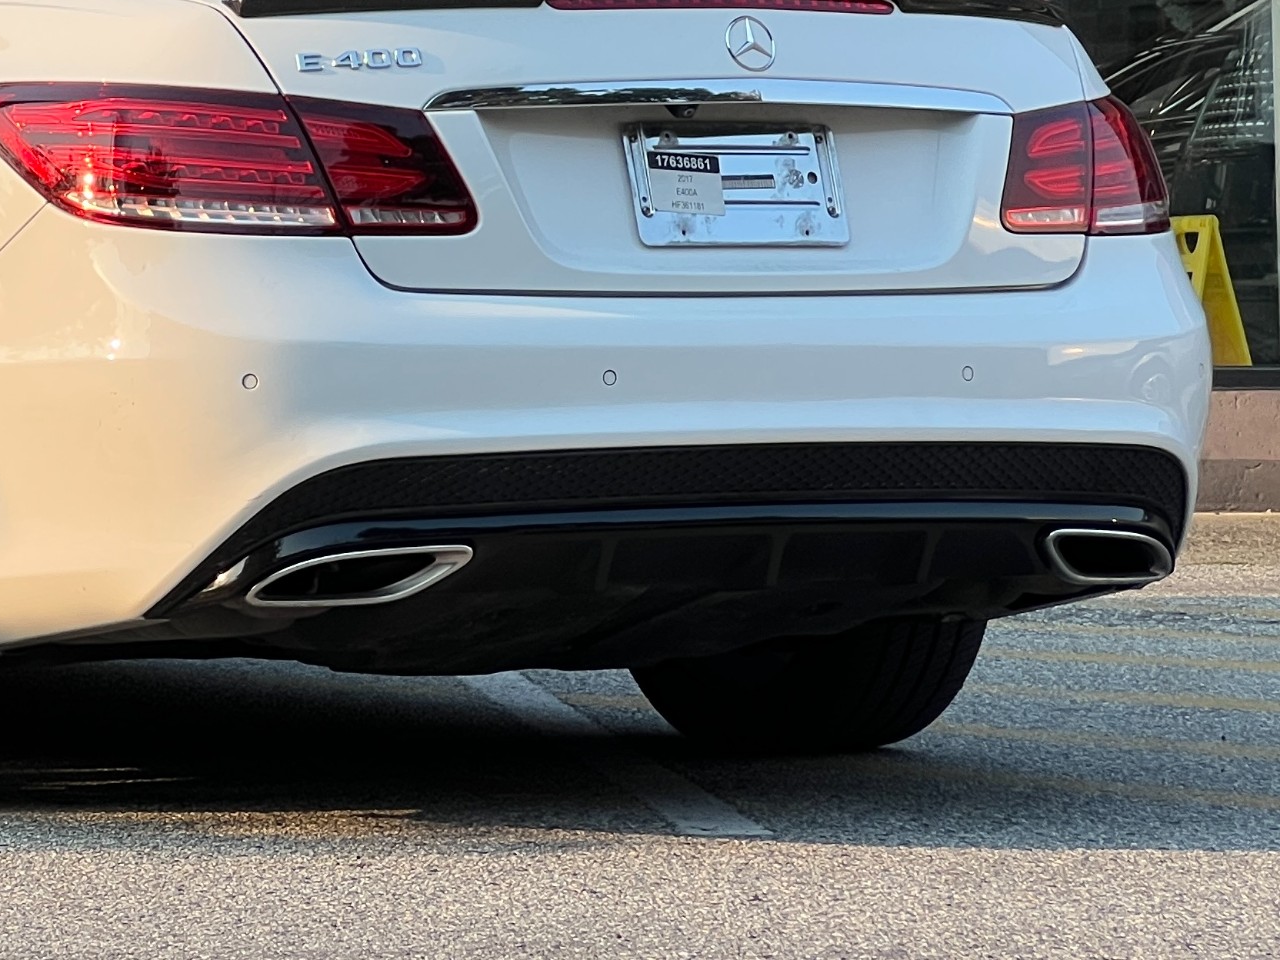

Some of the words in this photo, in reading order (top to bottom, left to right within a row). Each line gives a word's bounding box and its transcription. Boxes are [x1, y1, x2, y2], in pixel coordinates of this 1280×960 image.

[295, 52, 324, 72] E
[331, 47, 423, 71] 400
[655, 154, 710, 170] 17636861
